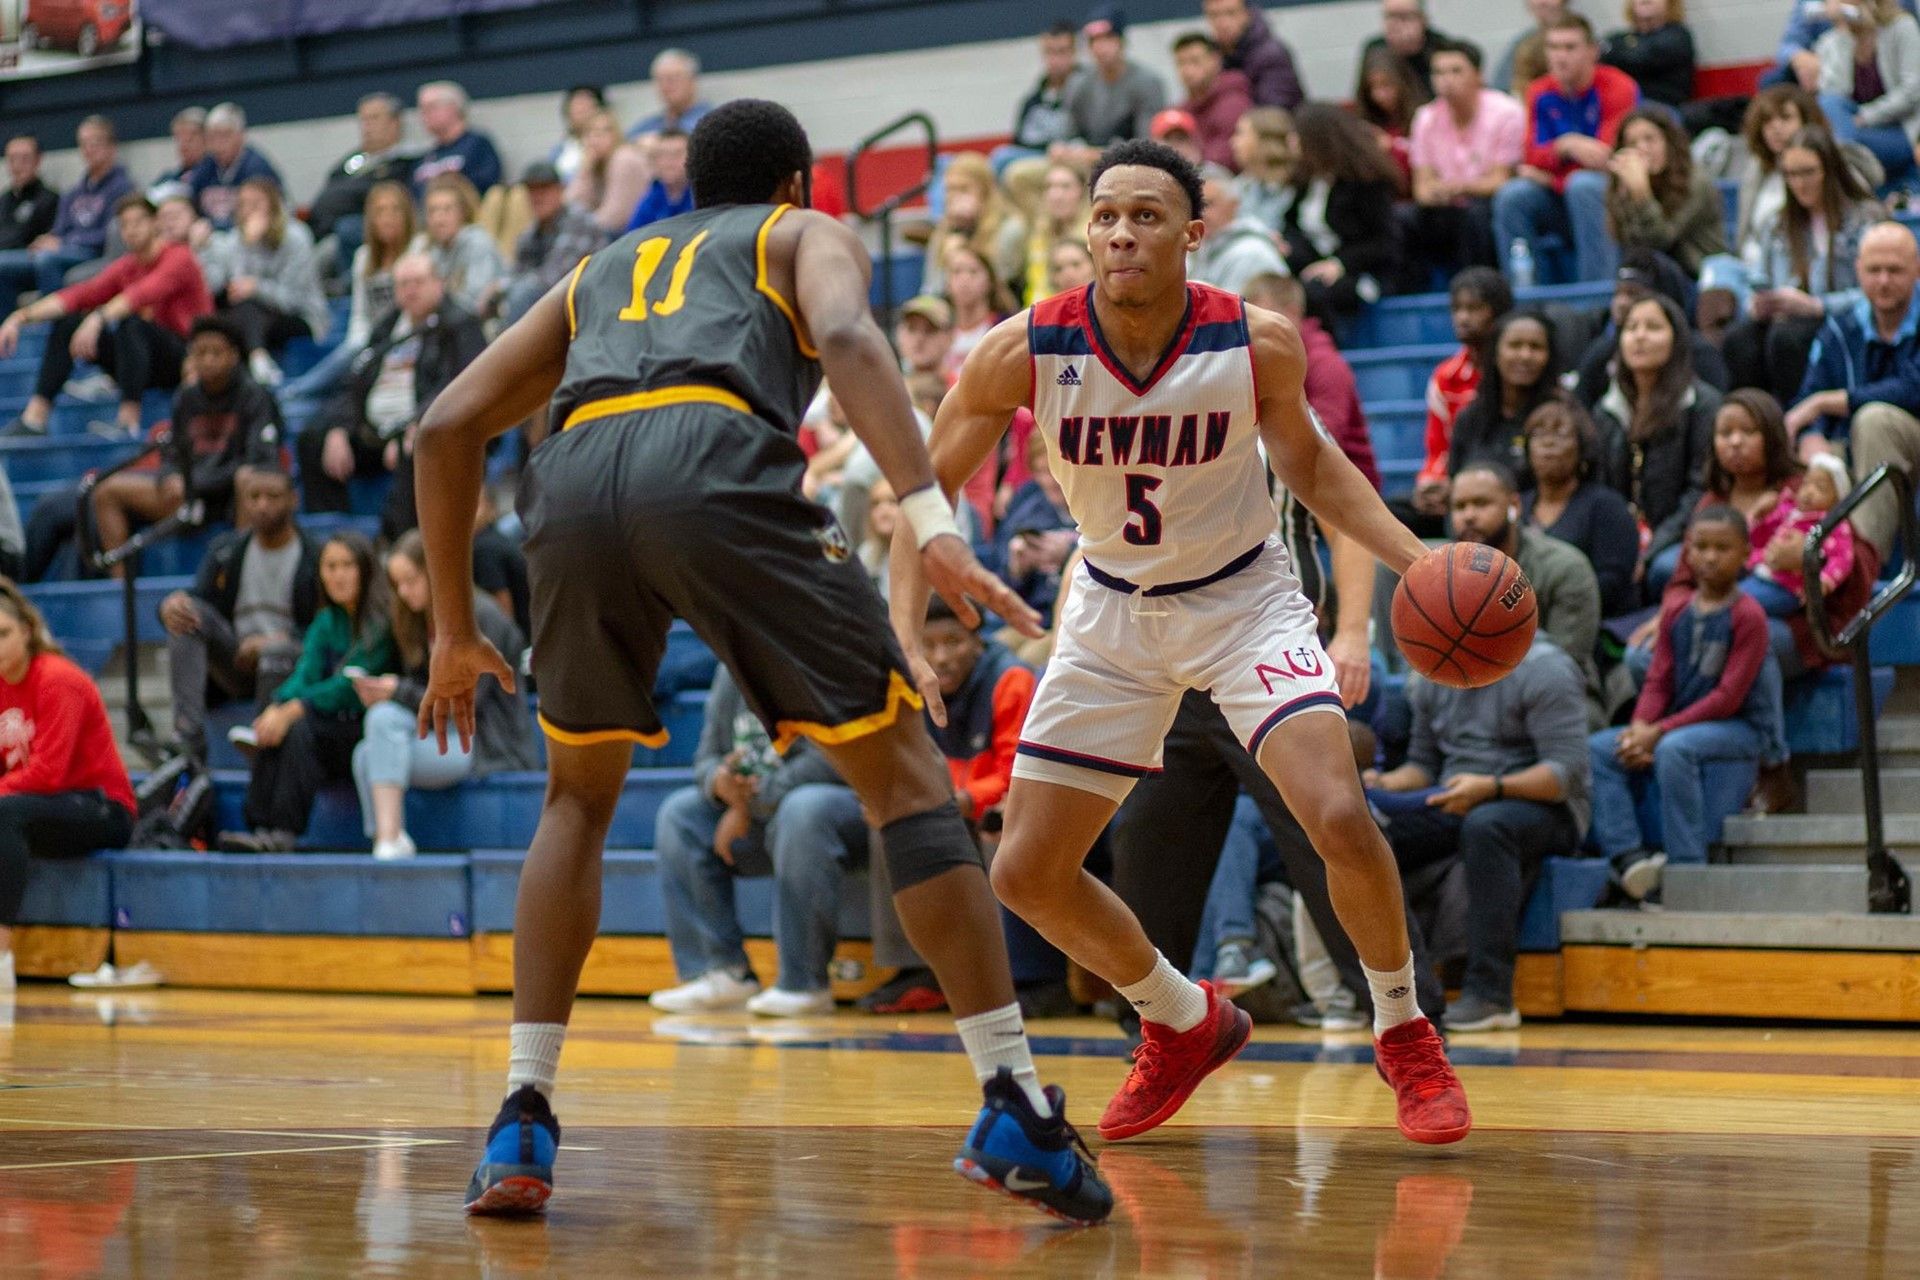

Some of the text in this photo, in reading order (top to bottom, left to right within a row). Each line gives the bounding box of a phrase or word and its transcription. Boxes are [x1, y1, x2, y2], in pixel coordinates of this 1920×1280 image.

[618, 229, 708, 321] 11
[1056, 377, 1082, 386] adidas
[1059, 411, 1231, 467] NEWMAN
[1122, 473, 1163, 546] 5
